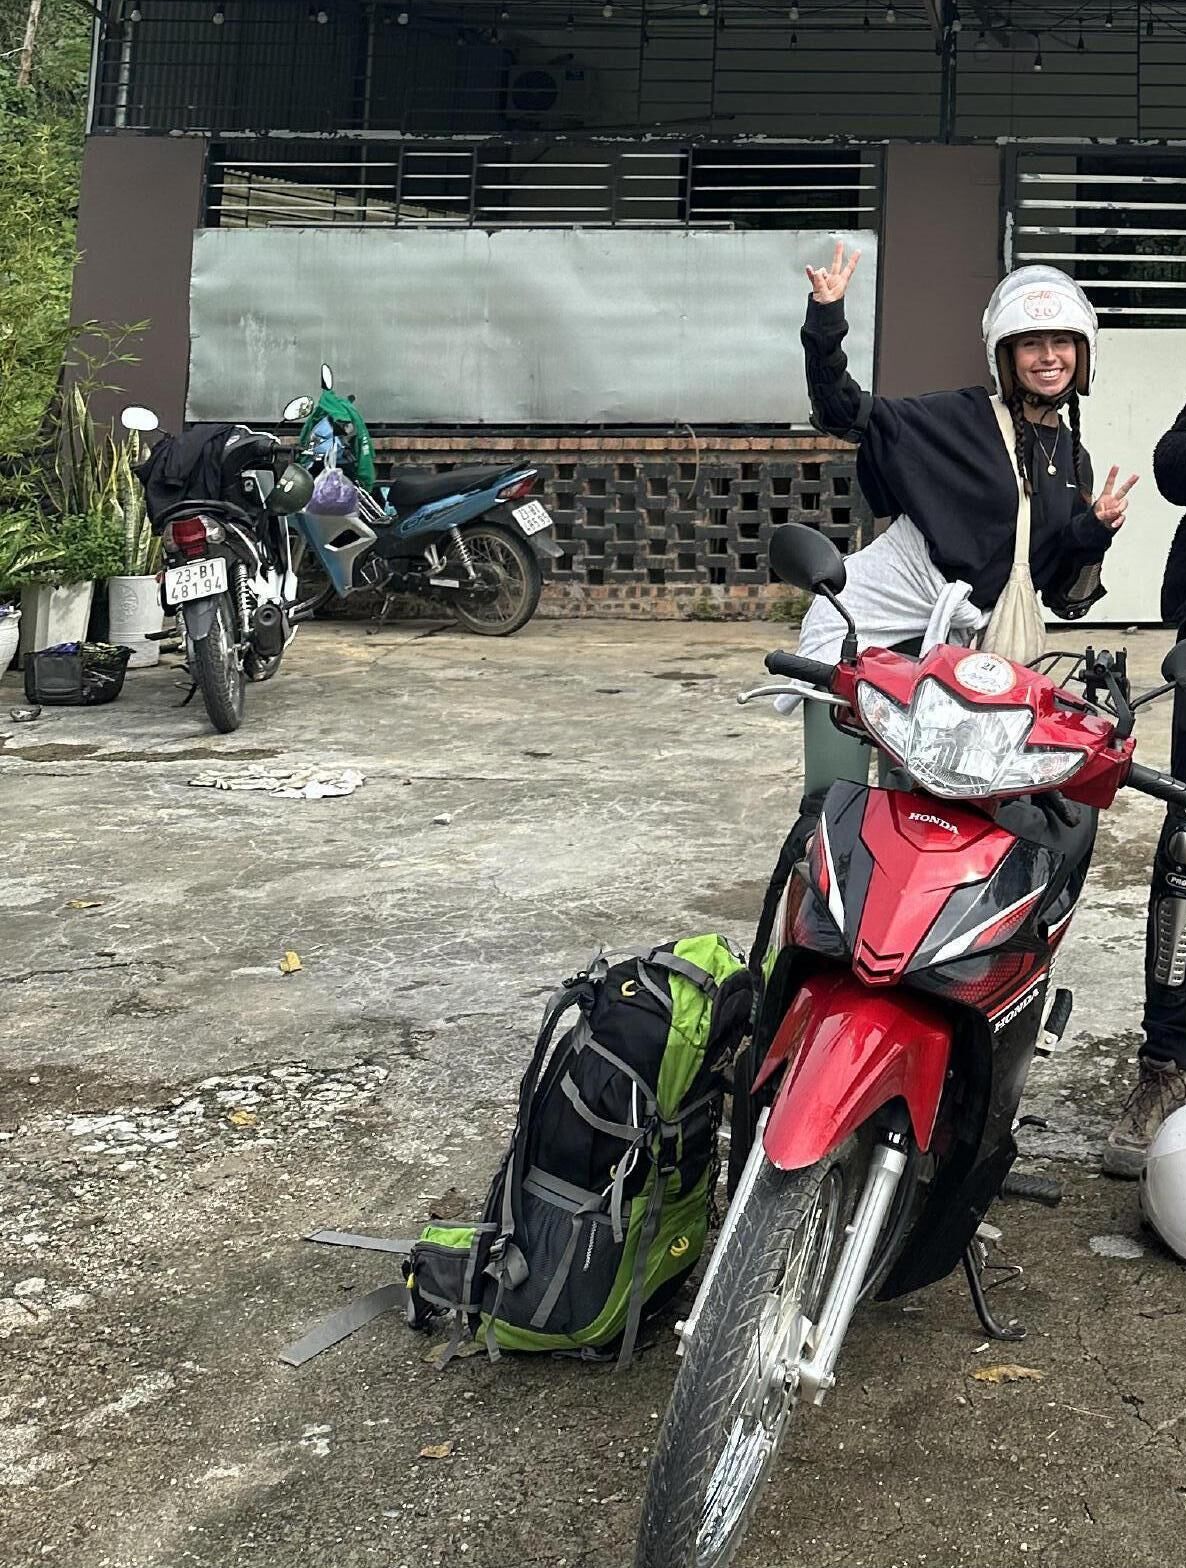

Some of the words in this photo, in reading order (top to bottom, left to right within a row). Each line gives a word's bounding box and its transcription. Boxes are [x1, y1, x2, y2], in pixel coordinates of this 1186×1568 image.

[176, 562, 215, 585] 23-B1
[908, 812, 960, 835] HONDA
[993, 988, 1040, 1034] HONDA
